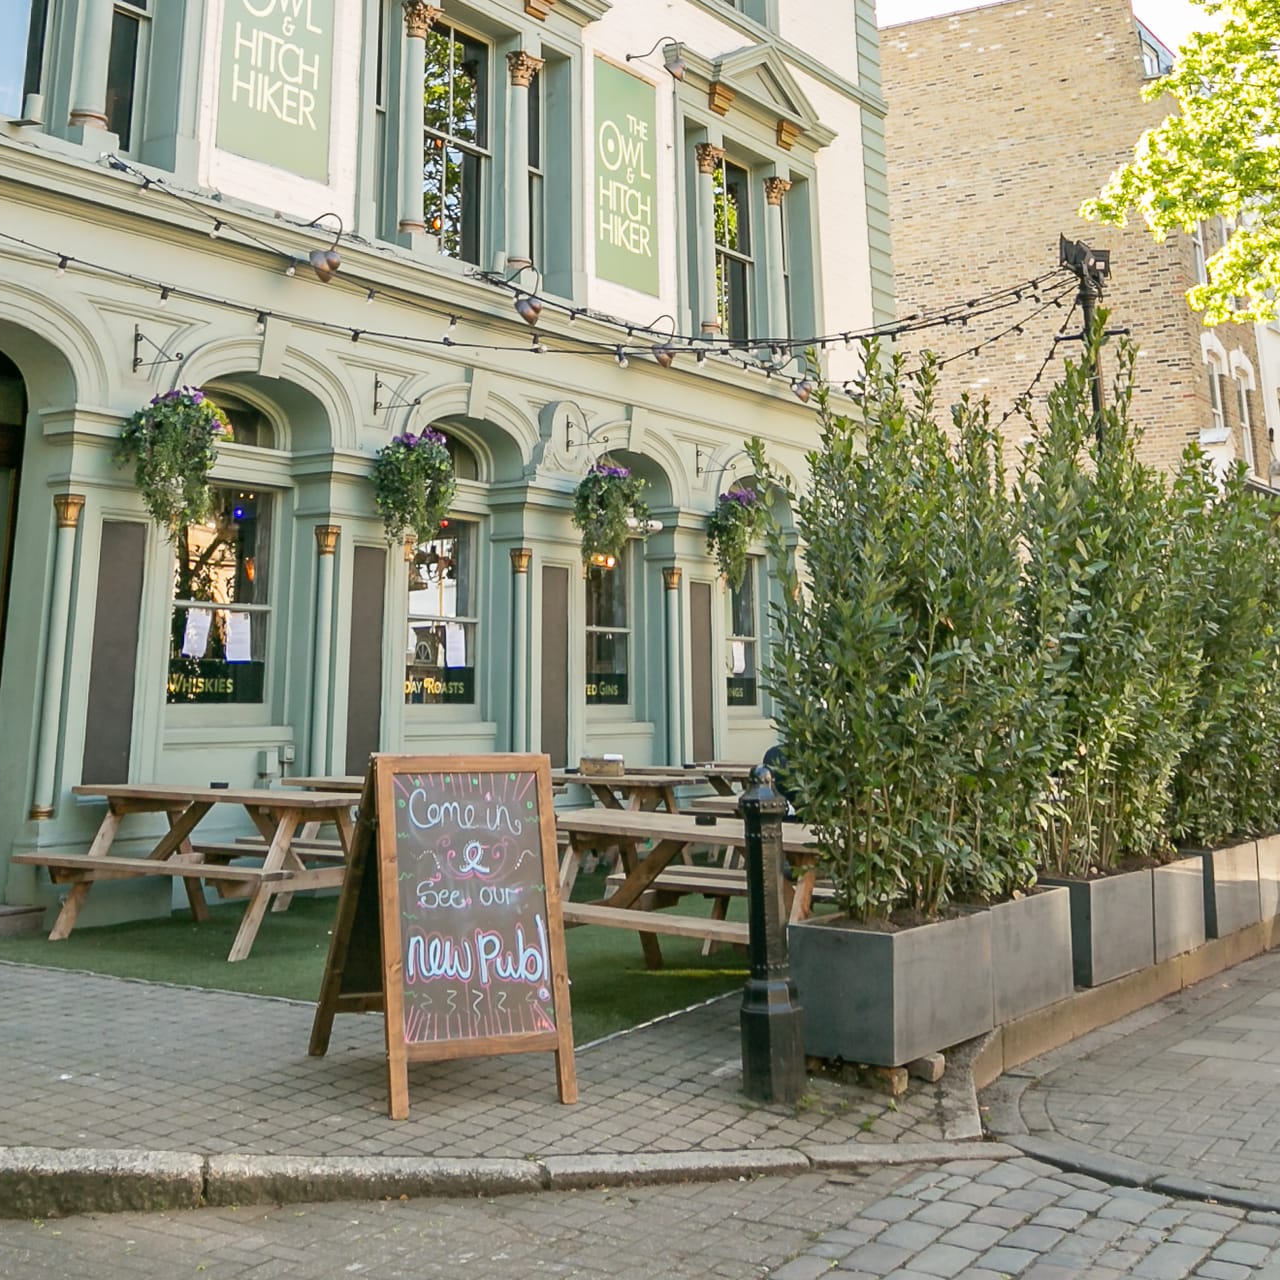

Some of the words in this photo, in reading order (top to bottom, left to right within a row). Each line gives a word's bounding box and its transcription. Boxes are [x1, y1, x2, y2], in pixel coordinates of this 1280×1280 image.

[282, 15, 296, 37] &
[234, 21, 320, 91] HITCH
[232, 63, 317, 131] HIKER
[599, 120, 652, 180] OWL
[626, 113, 649, 141] THE
[626, 167, 636, 184] &
[599, 175, 652, 226] HITCH
[599, 209, 652, 258] HIKER
[408, 788, 479, 829] Come
[416, 880, 470, 909] See
[479, 885, 517, 906] our
[406, 934, 473, 980] new
